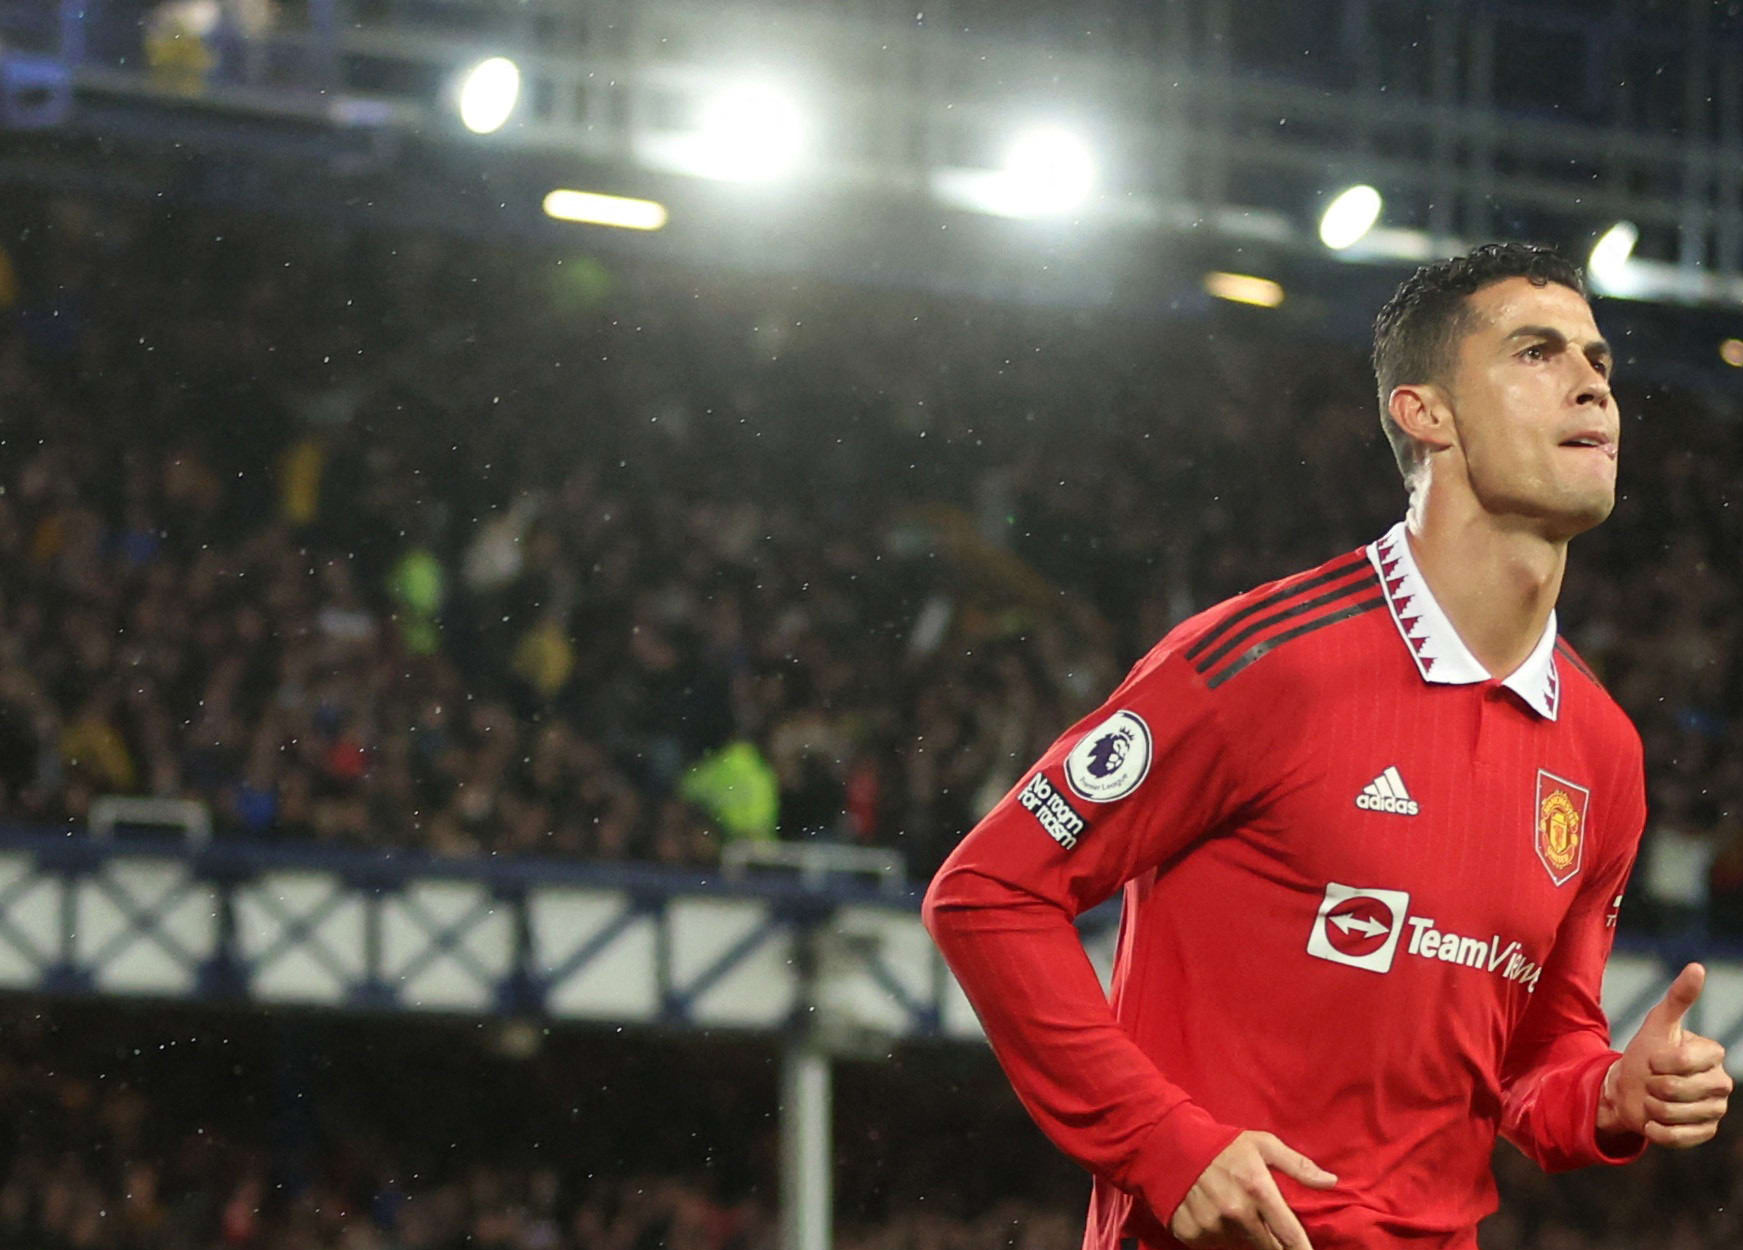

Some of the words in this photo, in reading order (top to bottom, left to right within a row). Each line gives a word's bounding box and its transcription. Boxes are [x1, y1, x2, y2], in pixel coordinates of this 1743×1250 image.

[1018, 787, 1042, 811] for
[1036, 805, 1077, 850] racism
[1027, 772, 1051, 799] No
[1048, 793, 1085, 834] room
[1356, 792, 1419, 815] adidas
